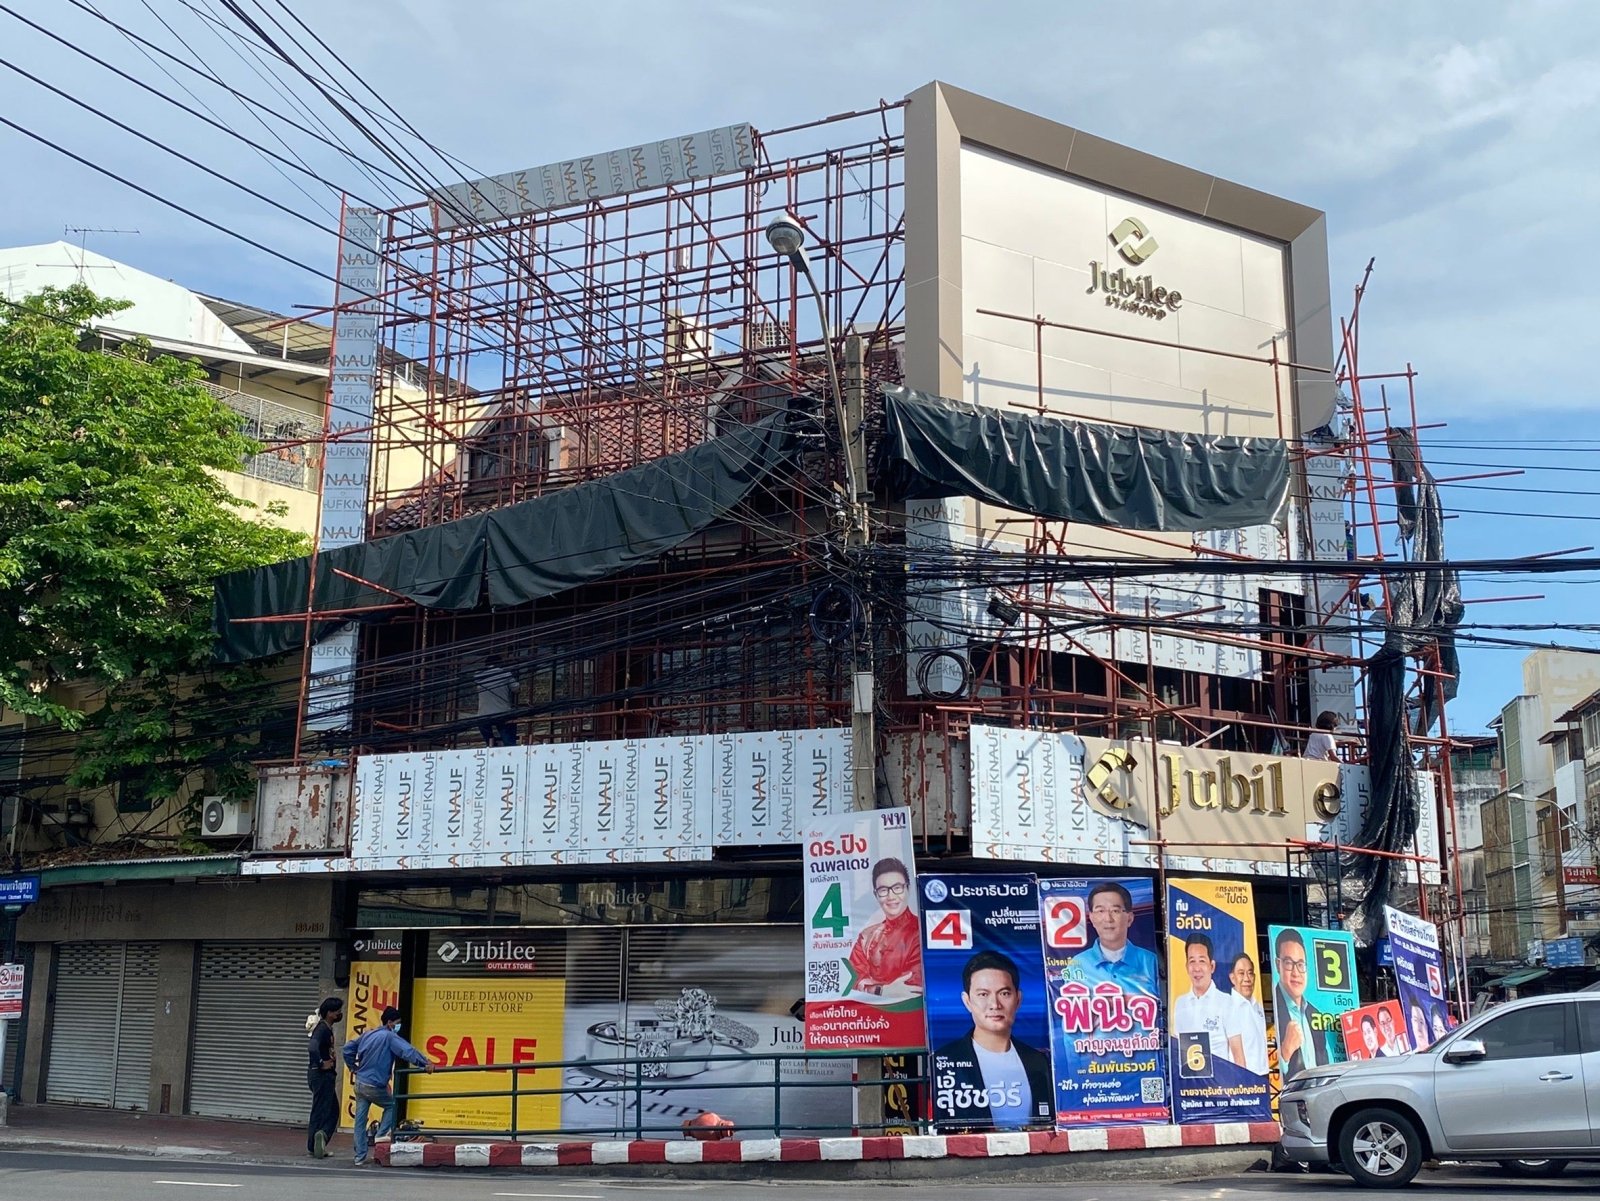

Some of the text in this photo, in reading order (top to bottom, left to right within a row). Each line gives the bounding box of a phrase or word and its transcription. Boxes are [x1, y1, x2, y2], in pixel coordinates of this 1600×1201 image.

[1086, 260, 1182, 313] Jubilee
[447, 768, 462, 838] KNAUF
[499, 765, 514, 835] KNAUF
[543, 763, 558, 834] KNAUF
[597, 760, 612, 831] KNAUF
[654, 757, 668, 830] KNAUF
[752, 752, 766, 827] KNAUF
[1016, 749, 1032, 827] KNAUF
[397, 771, 411, 840] KNAUF
[810, 858, 870, 873] ณพลเดช
[951, 884, 1028, 897] ประชาธิปัตย์
[1176, 899, 1188, 911] ทีม
[812, 883, 849, 937] 4
[1051, 901, 1083, 944] 2
[1176, 914, 1211, 930] อัศวิน
[365, 940, 402, 952] Jubilee
[931, 912, 967, 946] 4
[462, 941, 536, 964] Jubilee
[487, 962, 510, 970] OUTLET
[1323, 950, 1343, 986] 3
[434, 990, 534, 1001] JUBILEE DIAMOND
[1428, 966, 1441, 996] 5
[442, 1002, 523, 1013] OUTLET STORE
[1055, 981, 1158, 1032] พินิจ
[1334, 994, 1353, 1006] เลือก
[426, 1036, 537, 1074] SALE
[1088, 1059, 1156, 1074] สัมพันธวงศ์
[1187, 1044, 1205, 1071] 6
[936, 1070, 955, 1089] เอ้
[936, 1082, 1022, 1117] สุชัชวีร์
